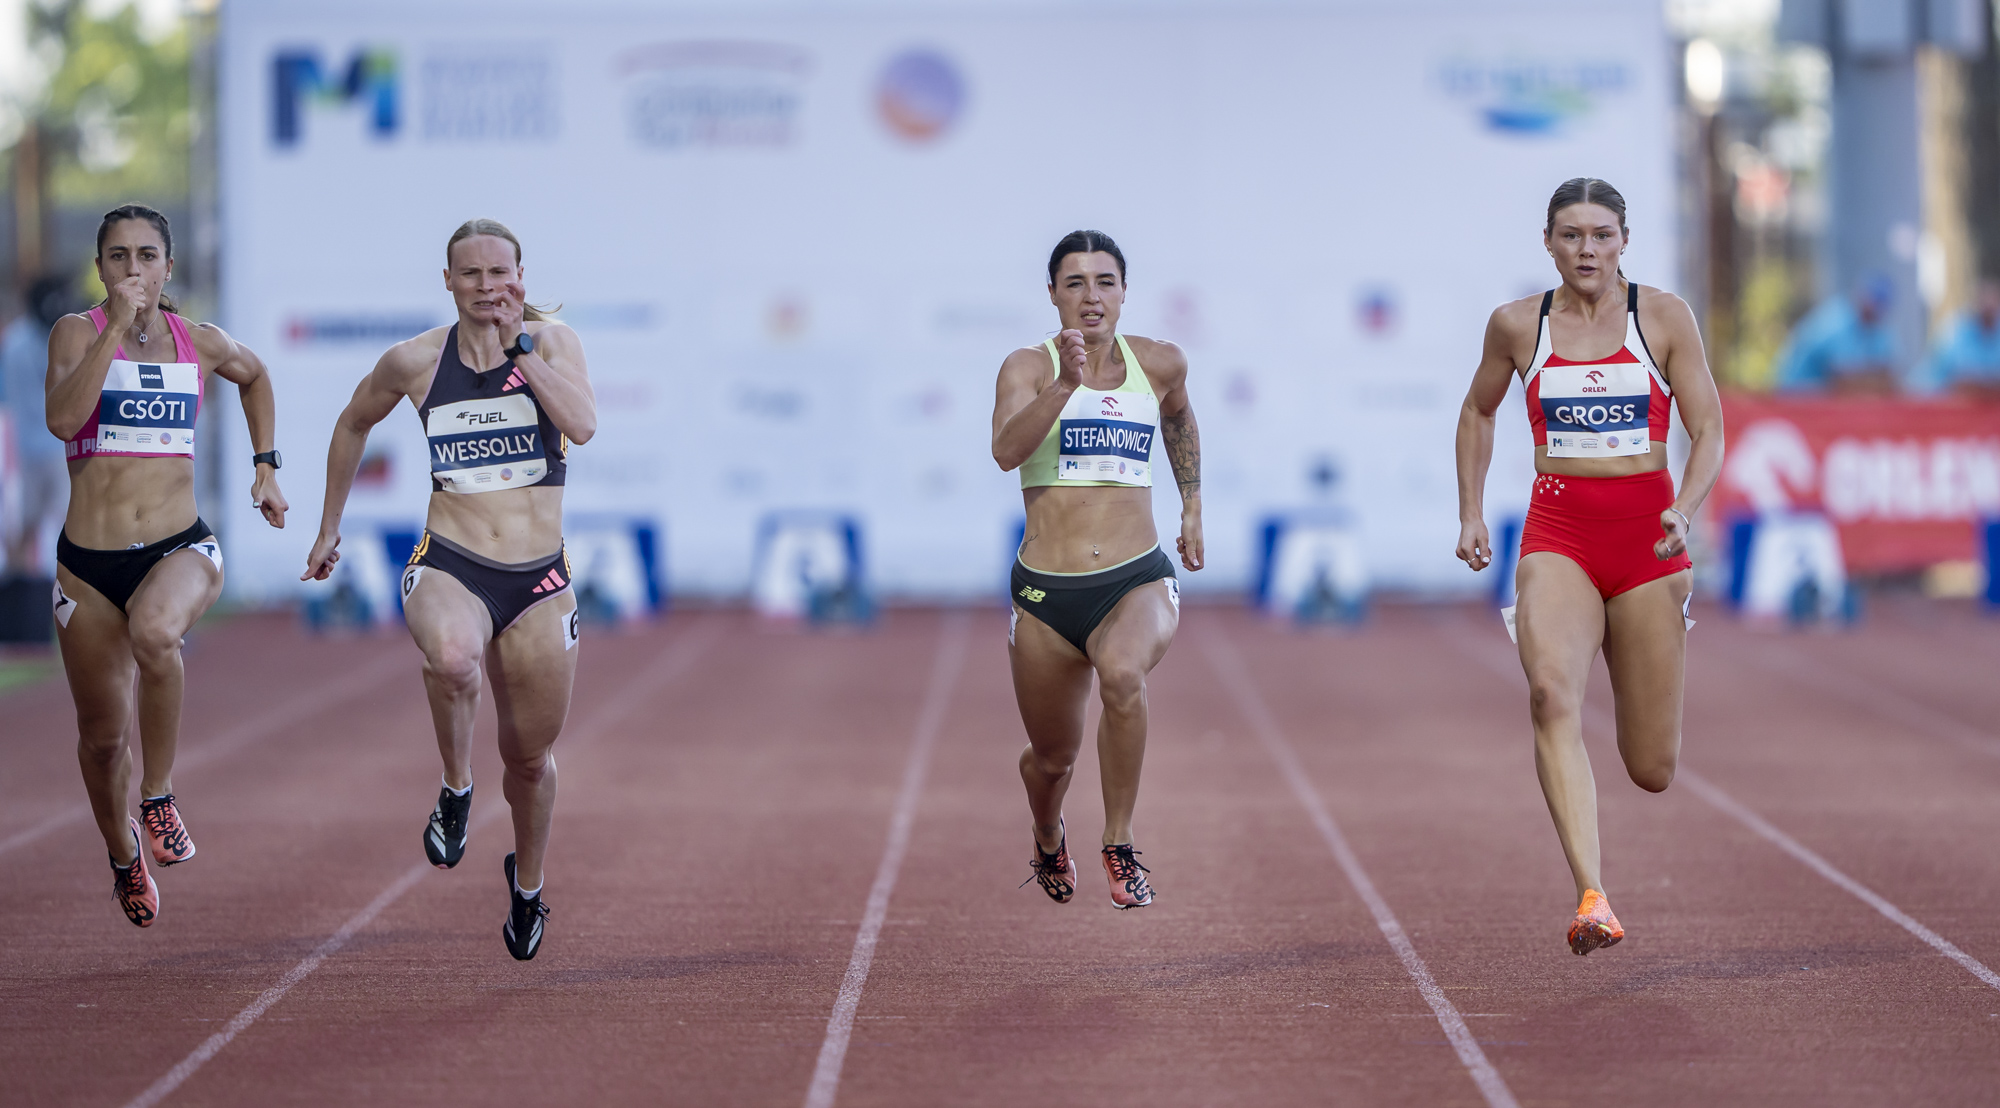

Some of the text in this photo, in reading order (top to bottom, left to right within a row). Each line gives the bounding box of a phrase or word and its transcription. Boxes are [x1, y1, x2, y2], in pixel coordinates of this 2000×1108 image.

[119, 395, 186, 421] CSÓTI
[469, 412, 508, 425] FUEL
[1555, 404, 1635, 425] GROSS
[434, 433, 536, 464] WESSOLLY
[1065, 427, 1150, 453] STEFANOWICZ
[403, 570, 415, 596] 6
